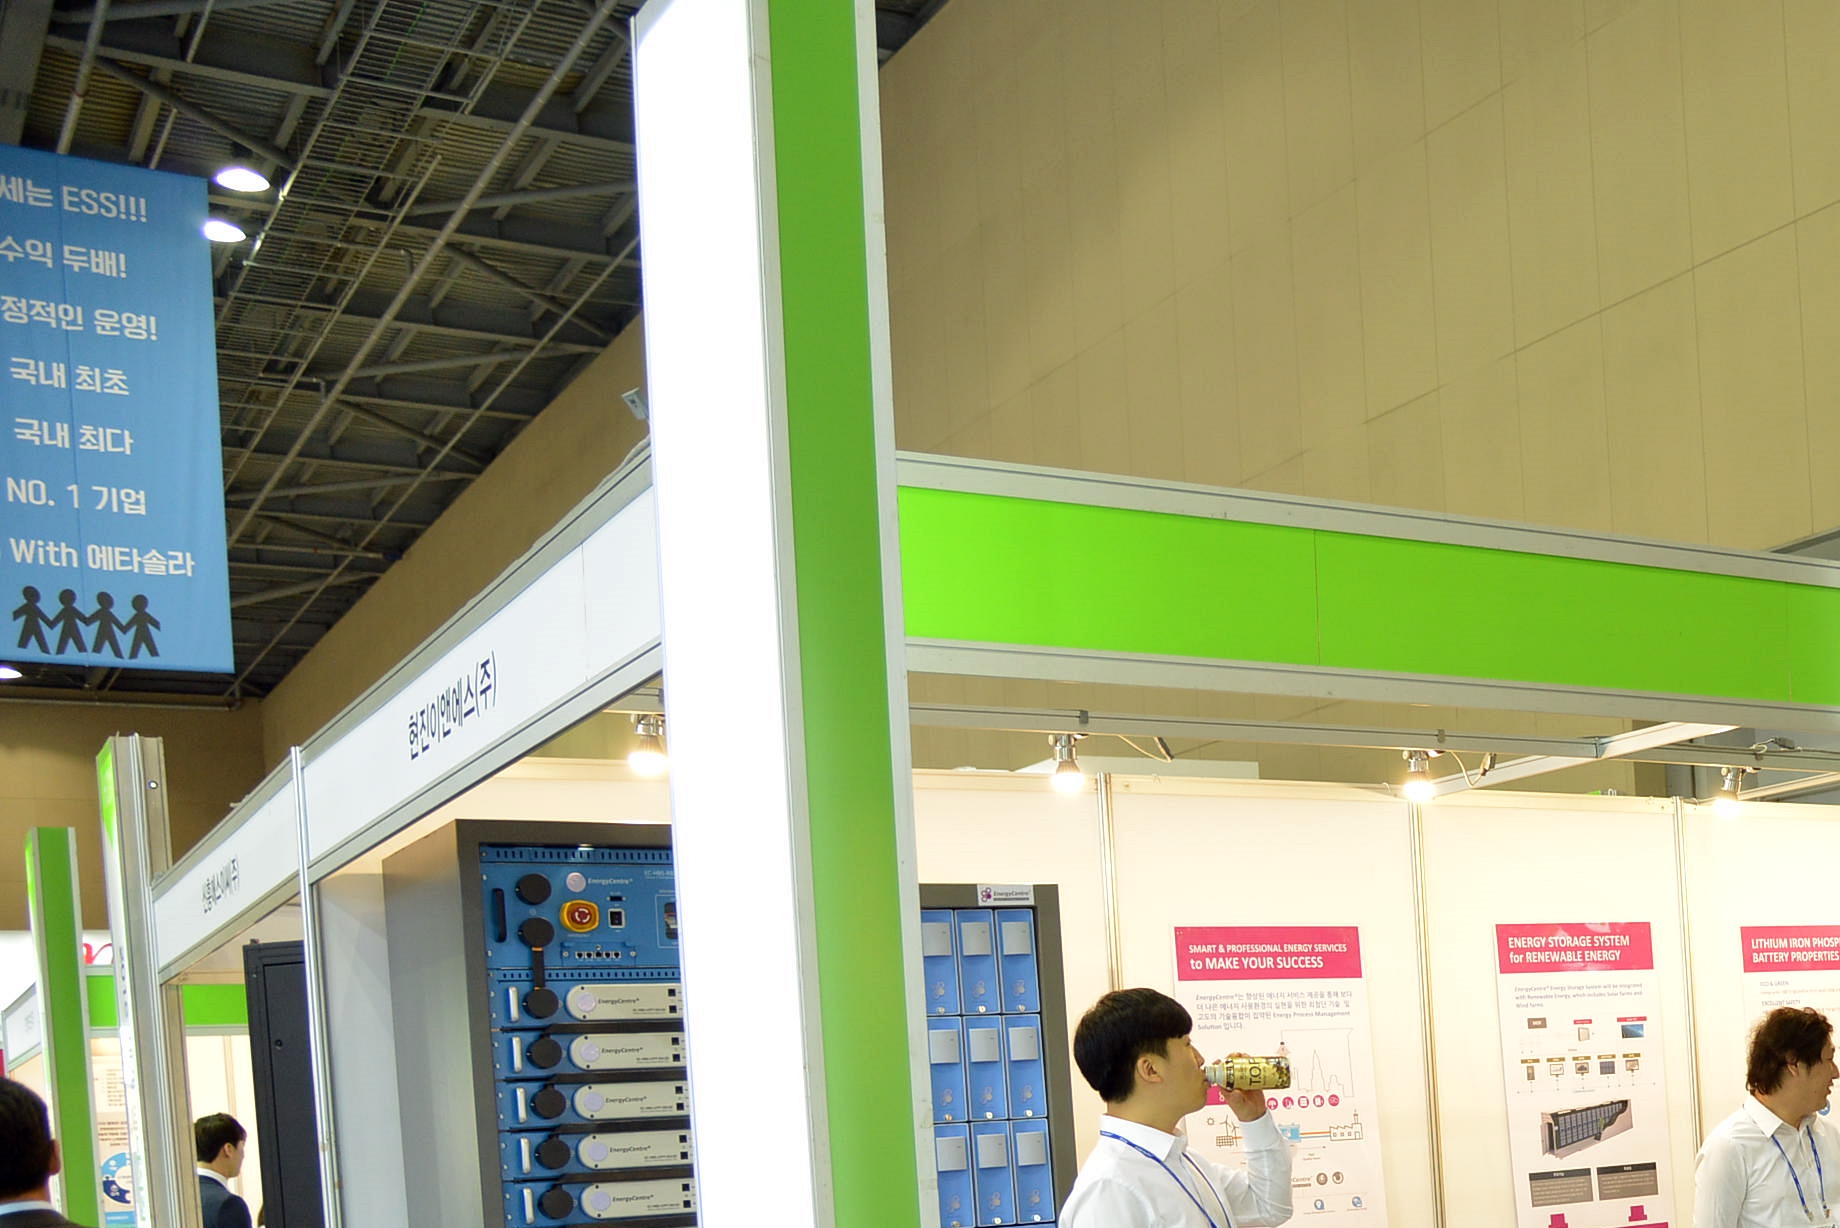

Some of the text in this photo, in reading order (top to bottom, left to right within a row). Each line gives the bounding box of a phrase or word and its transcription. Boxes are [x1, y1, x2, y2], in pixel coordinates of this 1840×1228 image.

[0, 175, 147, 222] 세는 ESS!!!
[0, 235, 127, 279] 수익 두배!
[0, 295, 158, 341] 정적인 운영!
[9, 357, 130, 396] 국내 최초
[14, 418, 134, 455] 국내 최다
[6, 476, 147, 515] NO. 1 기업
[9, 538, 196, 577] With 에타솔라
[409, 650, 497, 761] 현진이앤에스(주)
[1189, 943, 1347, 954] SMART & PROFESSIONAL ENERGY SERVICES
[1508, 935, 1630, 948] ENERGY STORAGE SYSTEM
[1510, 950, 1621, 963] for RENEWABLE ENERGY
[1751, 938, 1787, 949] LITHIUM
[1790, 937, 1810, 948] IRON
[1752, 950, 1840, 964] BATTERY PROPERTIES
[1190, 956, 1324, 970] to MAKE YOUR SUCCESS
